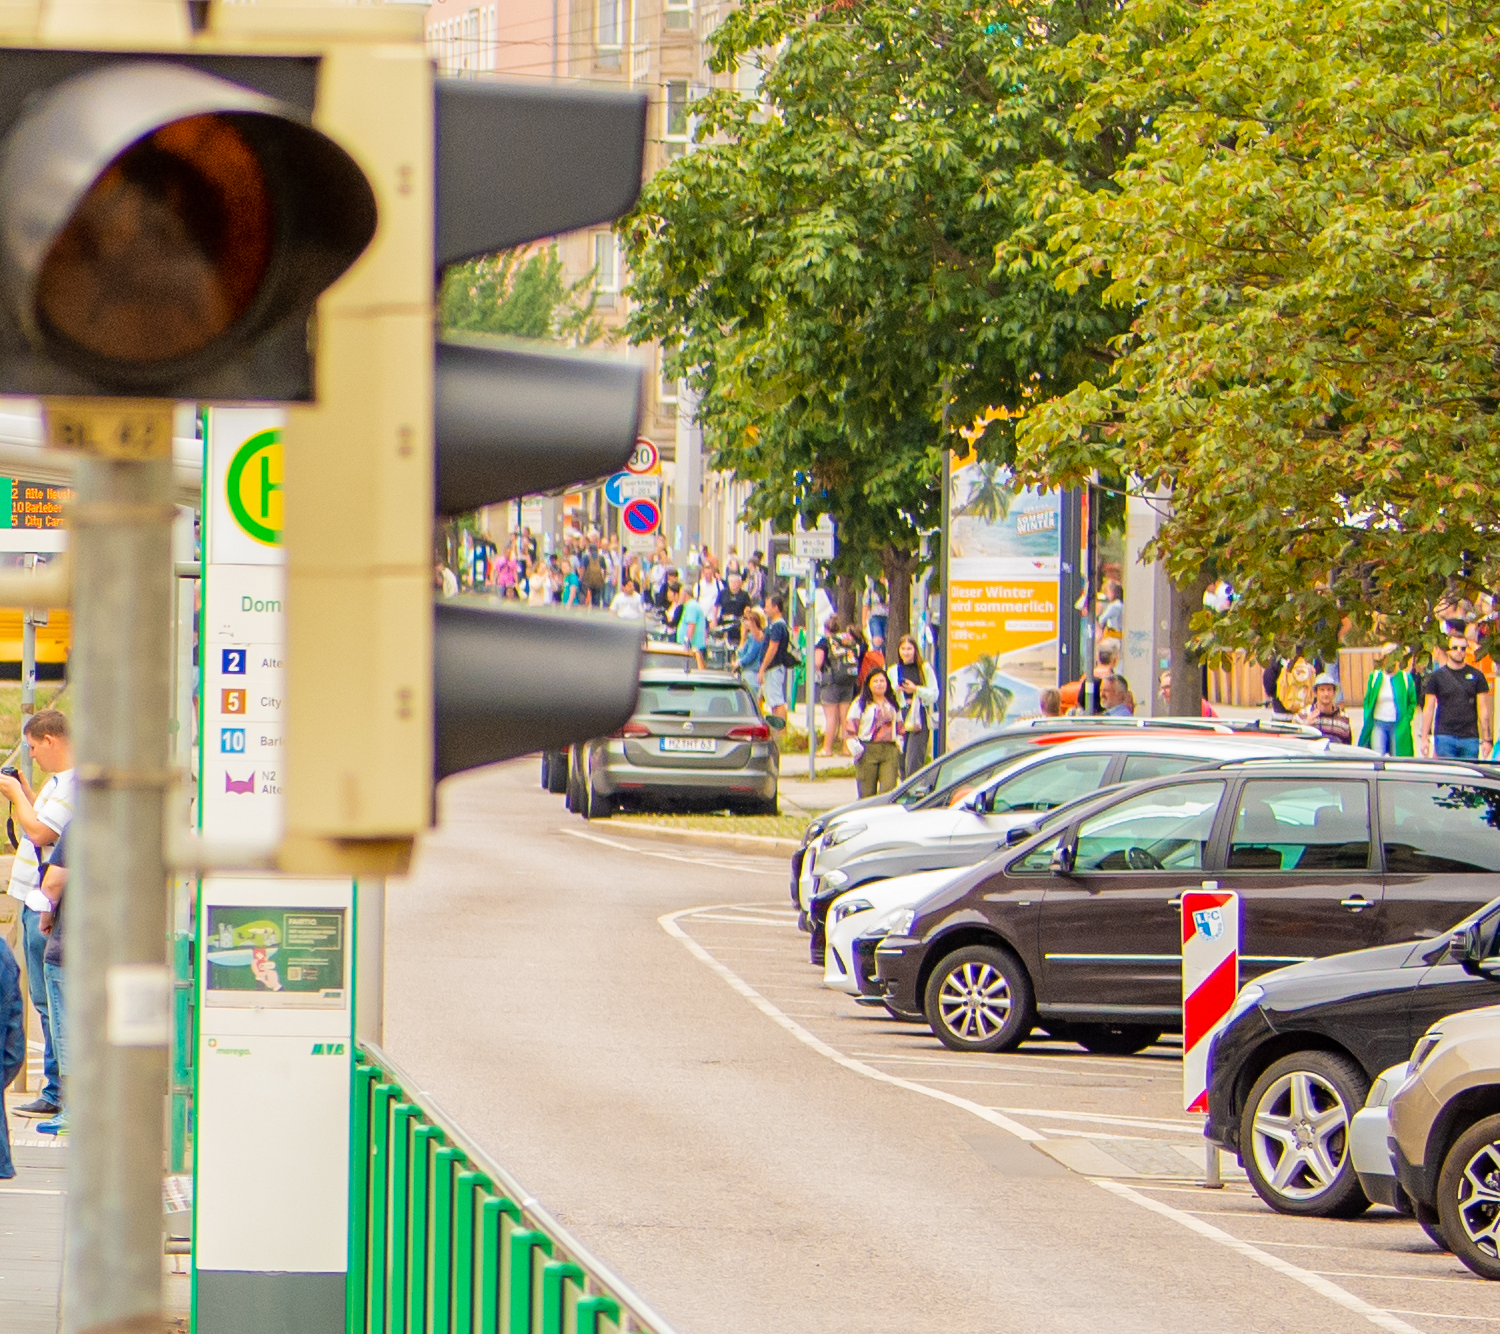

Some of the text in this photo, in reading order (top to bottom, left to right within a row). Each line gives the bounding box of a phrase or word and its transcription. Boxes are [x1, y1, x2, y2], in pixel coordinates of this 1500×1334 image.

[986, 586, 1035, 598] Winter
[974, 600, 1055, 612] sommerlich
[228, 653, 240, 671] 2
[228, 692, 282, 710] 5 City
[223, 731, 244, 751] 10
[262, 771, 276, 781] N2
